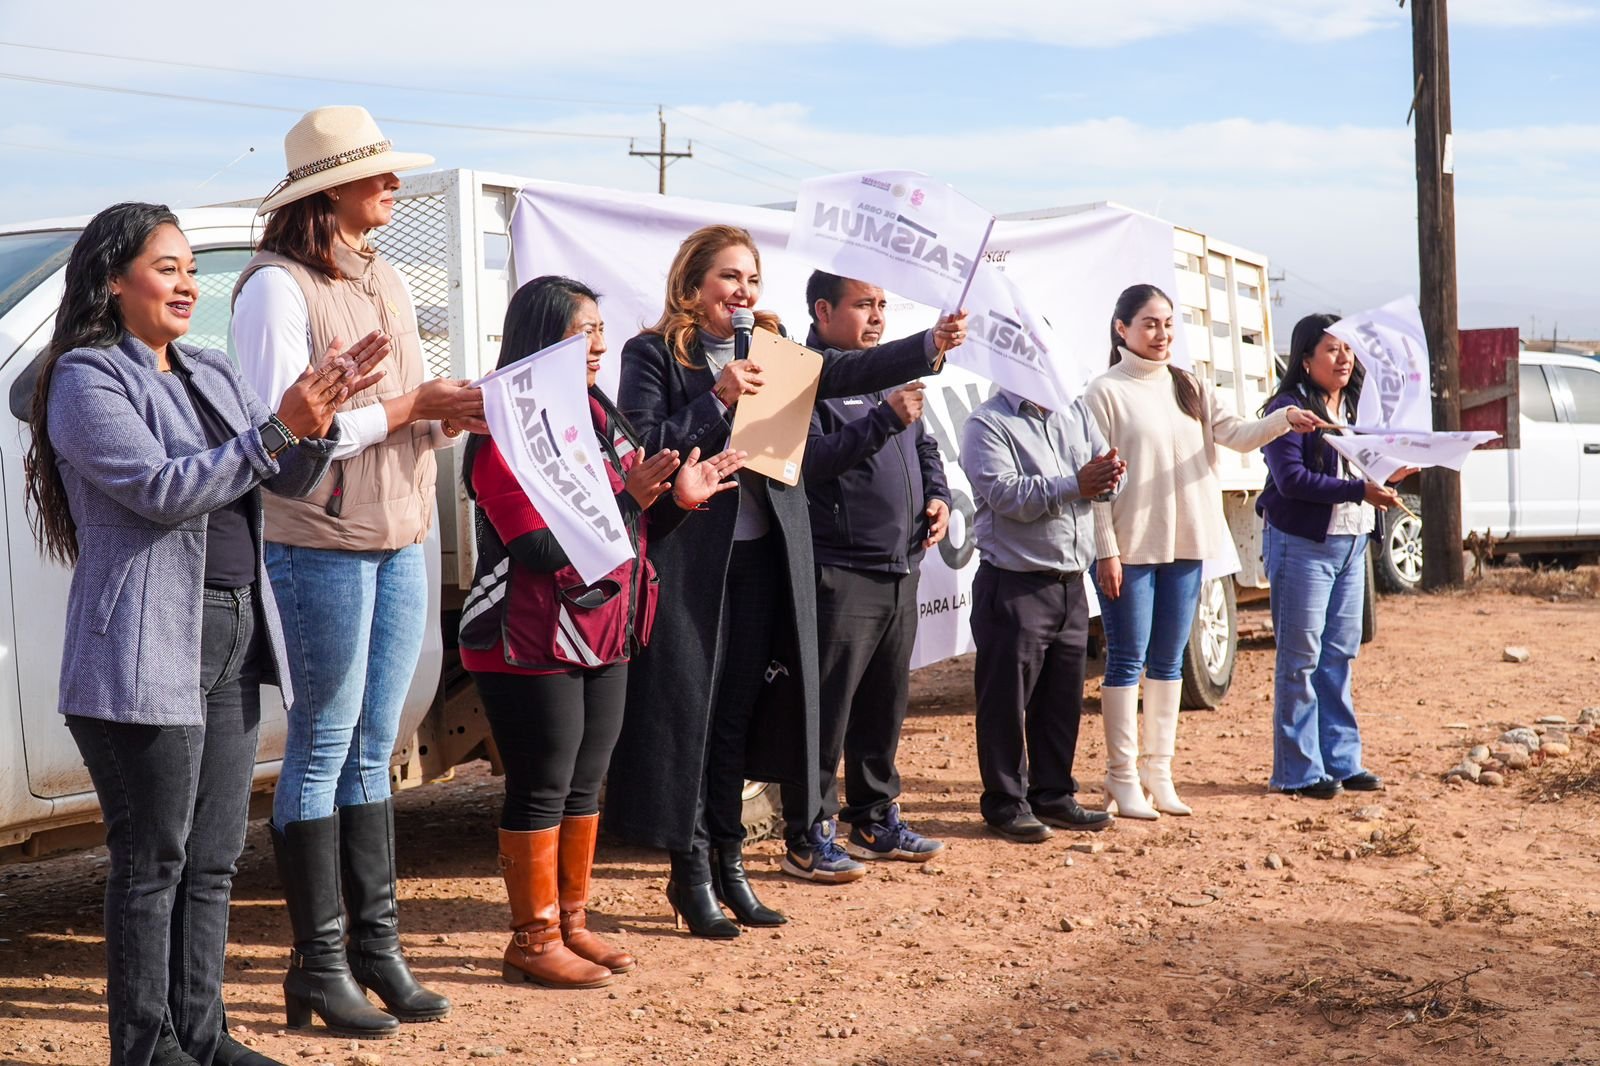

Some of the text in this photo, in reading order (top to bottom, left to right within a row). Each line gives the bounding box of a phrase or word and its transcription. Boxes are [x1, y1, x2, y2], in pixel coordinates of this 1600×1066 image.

[511, 367, 622, 543] FAISMUN
[559, 457, 570, 473] DE
[570, 474, 592, 498] OBRA
[920, 596, 949, 619] PARA
[952, 593, 966, 610] LA
